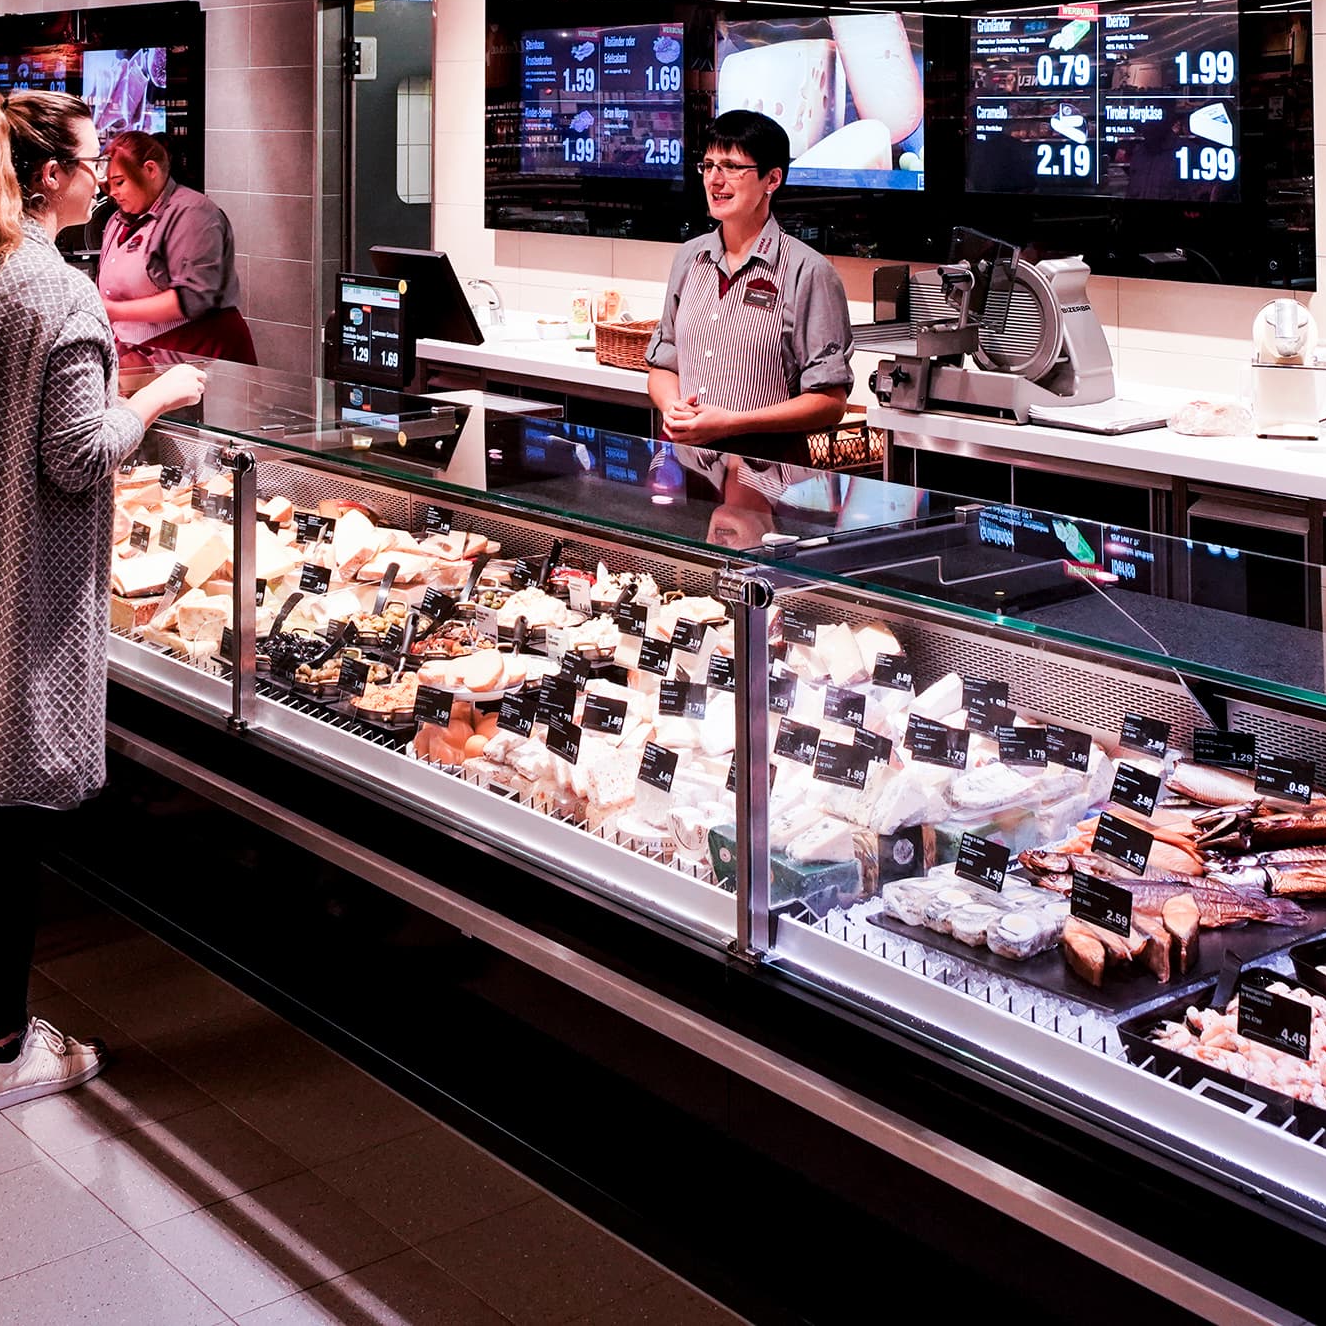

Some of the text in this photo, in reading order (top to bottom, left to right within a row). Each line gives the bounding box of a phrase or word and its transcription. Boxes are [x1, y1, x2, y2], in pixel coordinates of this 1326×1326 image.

[1037, 54, 1091, 86] 0.79
[1175, 51, 1235, 84] 1.99
[563, 67, 595, 92] 1.59
[646, 65, 681, 91] 1.69
[976, 105, 1008, 120] Caramello
[1105, 105, 1163, 123] Tiroler Bergkäse
[562, 137, 595, 162] 1.99
[644, 138, 681, 164] 2.59
[1037, 143, 1091, 177] 2.19
[1175, 146, 1236, 181] 1.99
[1061, 304, 1092, 314] BIZERBA
[352, 345, 369, 363] 1.29
[381, 350, 399, 368] 1.69
[946, 749, 966, 762] 1.79
[1028, 749, 1046, 760] 1.79
[1232, 752, 1253, 763] 1.29
[846, 768, 865, 781] 1.99
[1289, 782, 1310, 795] 0.99
[1126, 849, 1146, 866] 1.39
[986, 867, 1003, 882] 1.39
[1106, 909, 1128, 927] 2.59
[1281, 1028, 1307, 1047] 4.49
